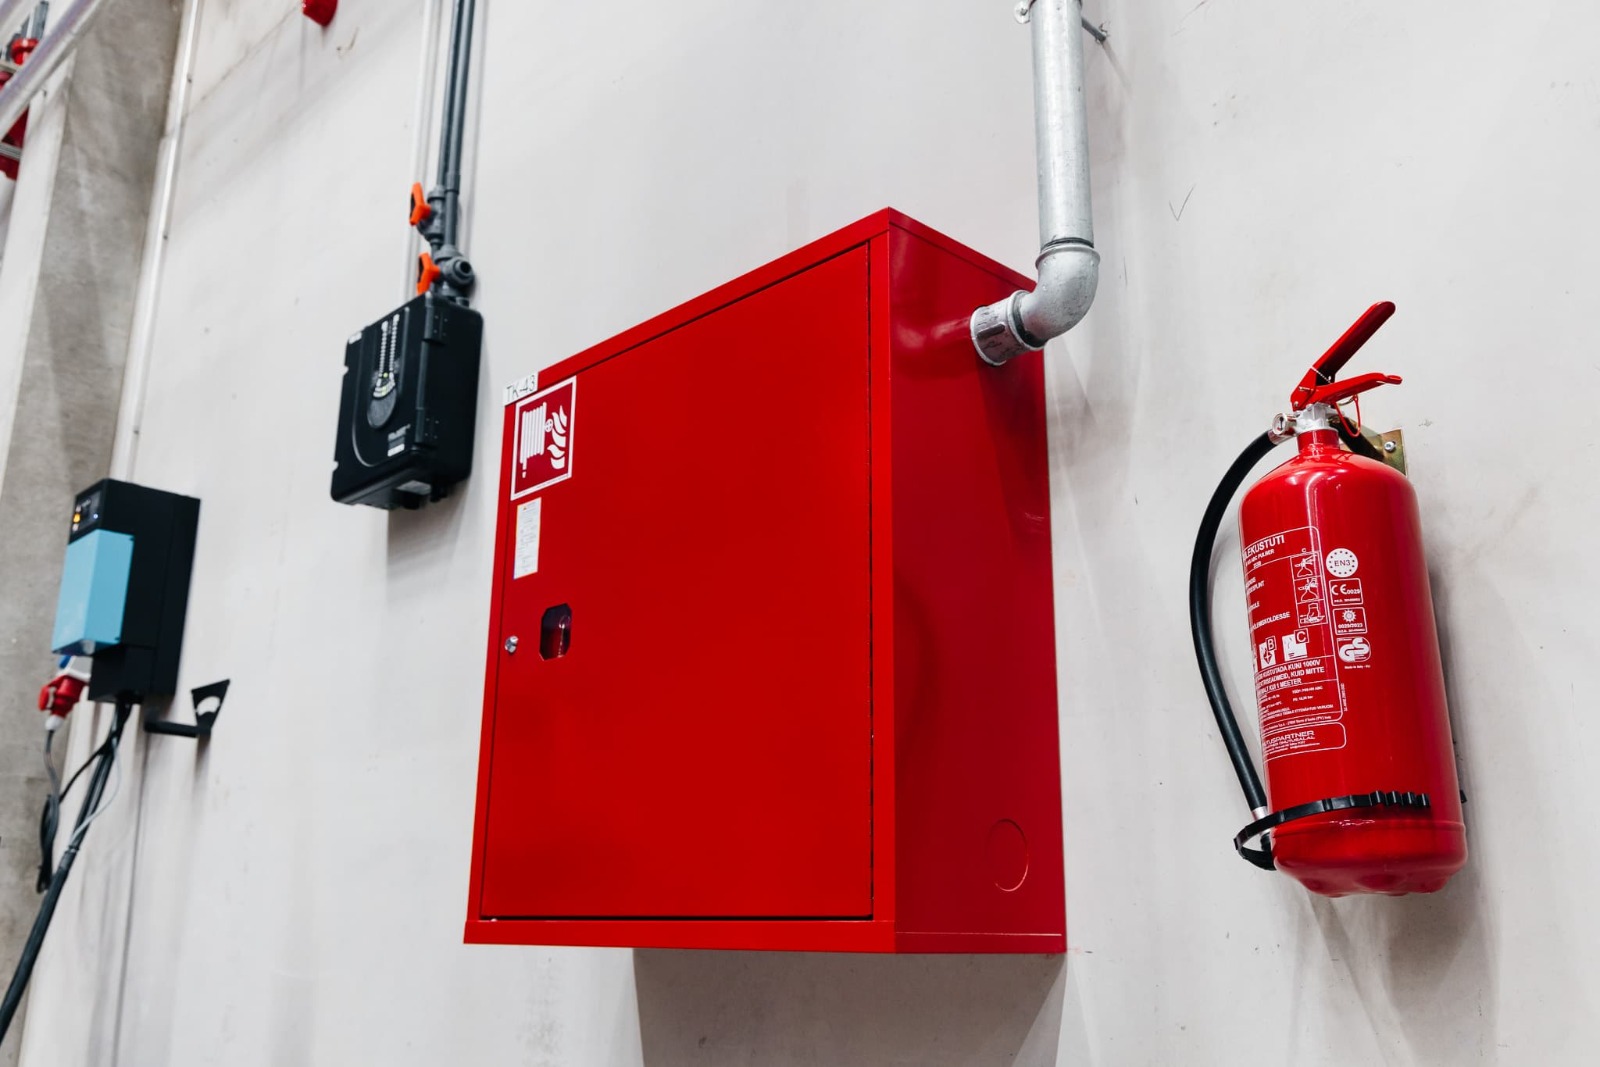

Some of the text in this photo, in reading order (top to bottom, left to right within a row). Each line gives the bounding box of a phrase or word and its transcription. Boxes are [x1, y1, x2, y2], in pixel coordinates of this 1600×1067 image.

[1243, 535, 1285, 559] LEKUSTUTI
[1334, 559, 1351, 568] EN3
[1296, 631, 1307, 642] C
[1267, 638, 1275, 650] B
[1306, 666, 1325, 675] MITTE
[1264, 730, 1314, 747] TUSPARTNER
